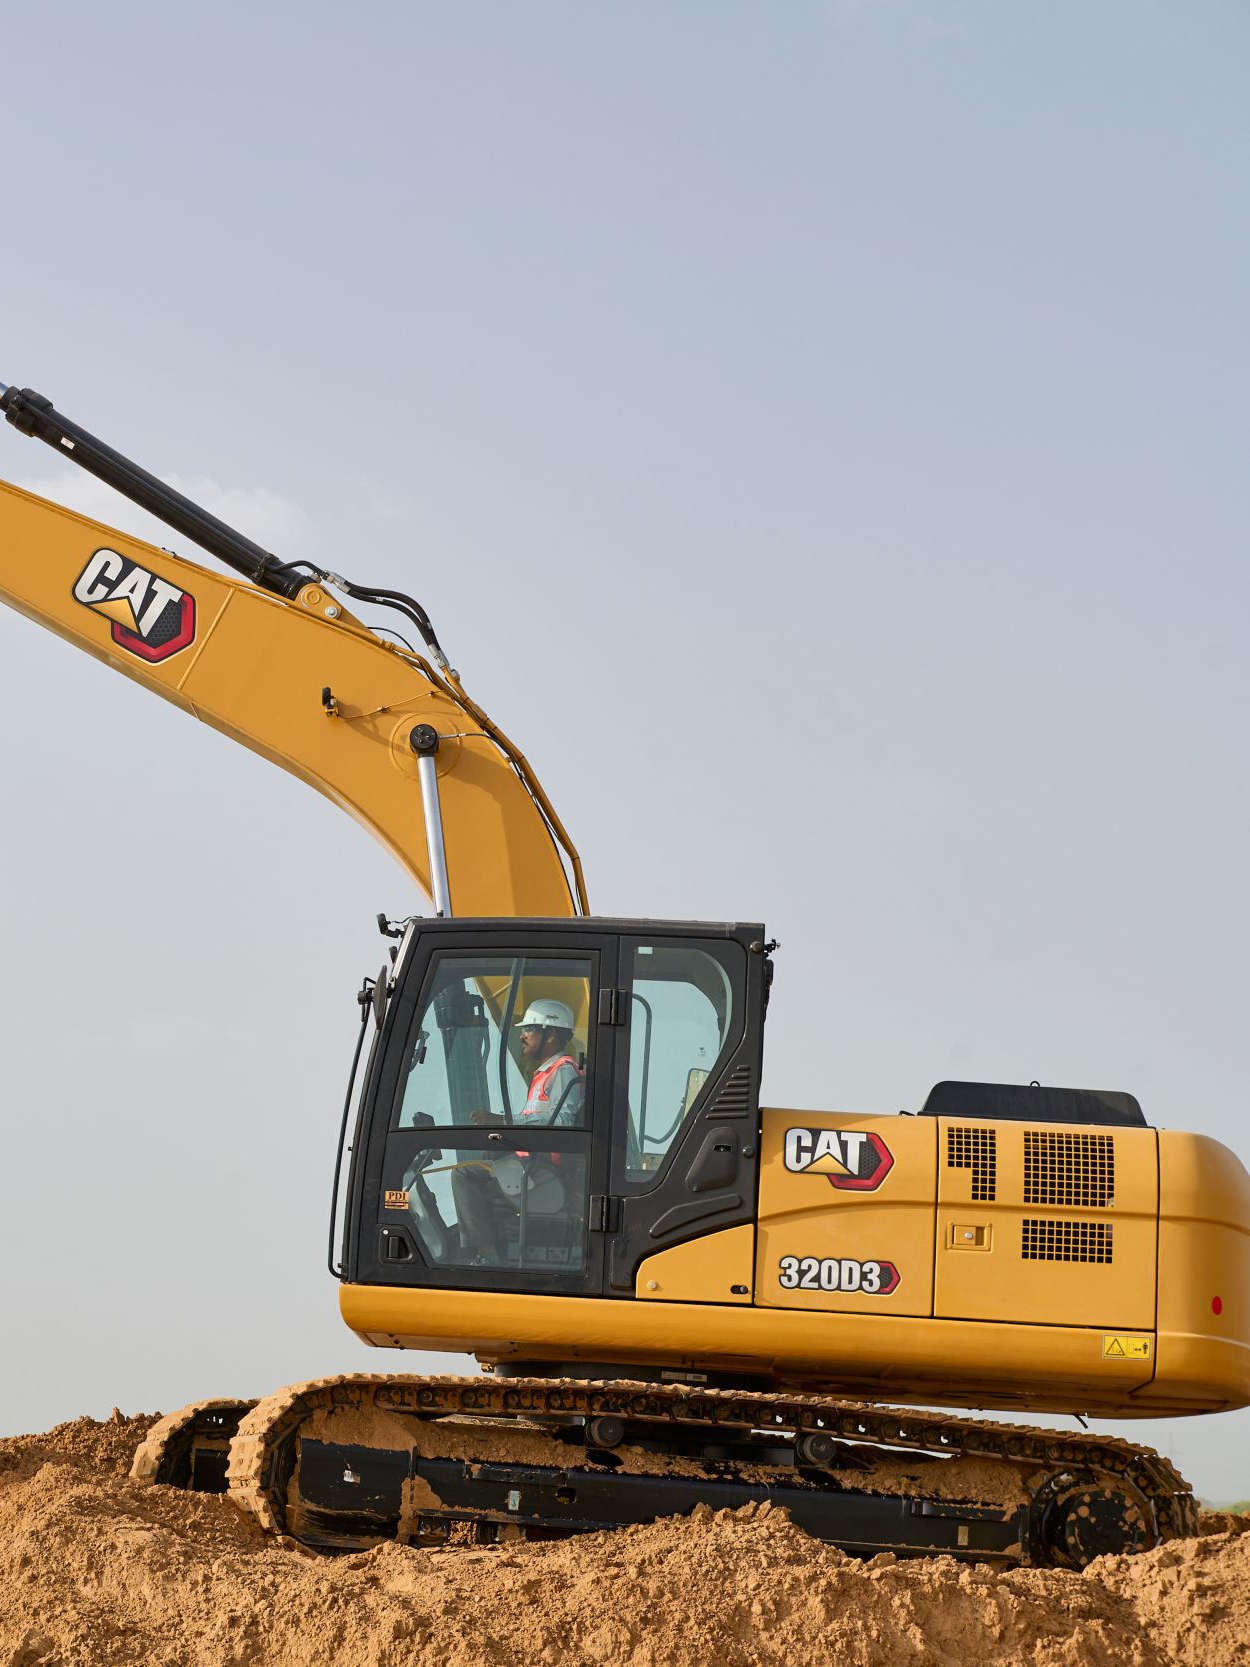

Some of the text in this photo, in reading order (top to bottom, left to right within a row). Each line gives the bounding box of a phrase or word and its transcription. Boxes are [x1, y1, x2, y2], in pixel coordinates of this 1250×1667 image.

[75, 549, 184, 638] CAT
[785, 1128, 867, 1175] CAT
[388, 1191, 406, 1200] PDI
[780, 1256, 881, 1292] 320D3
